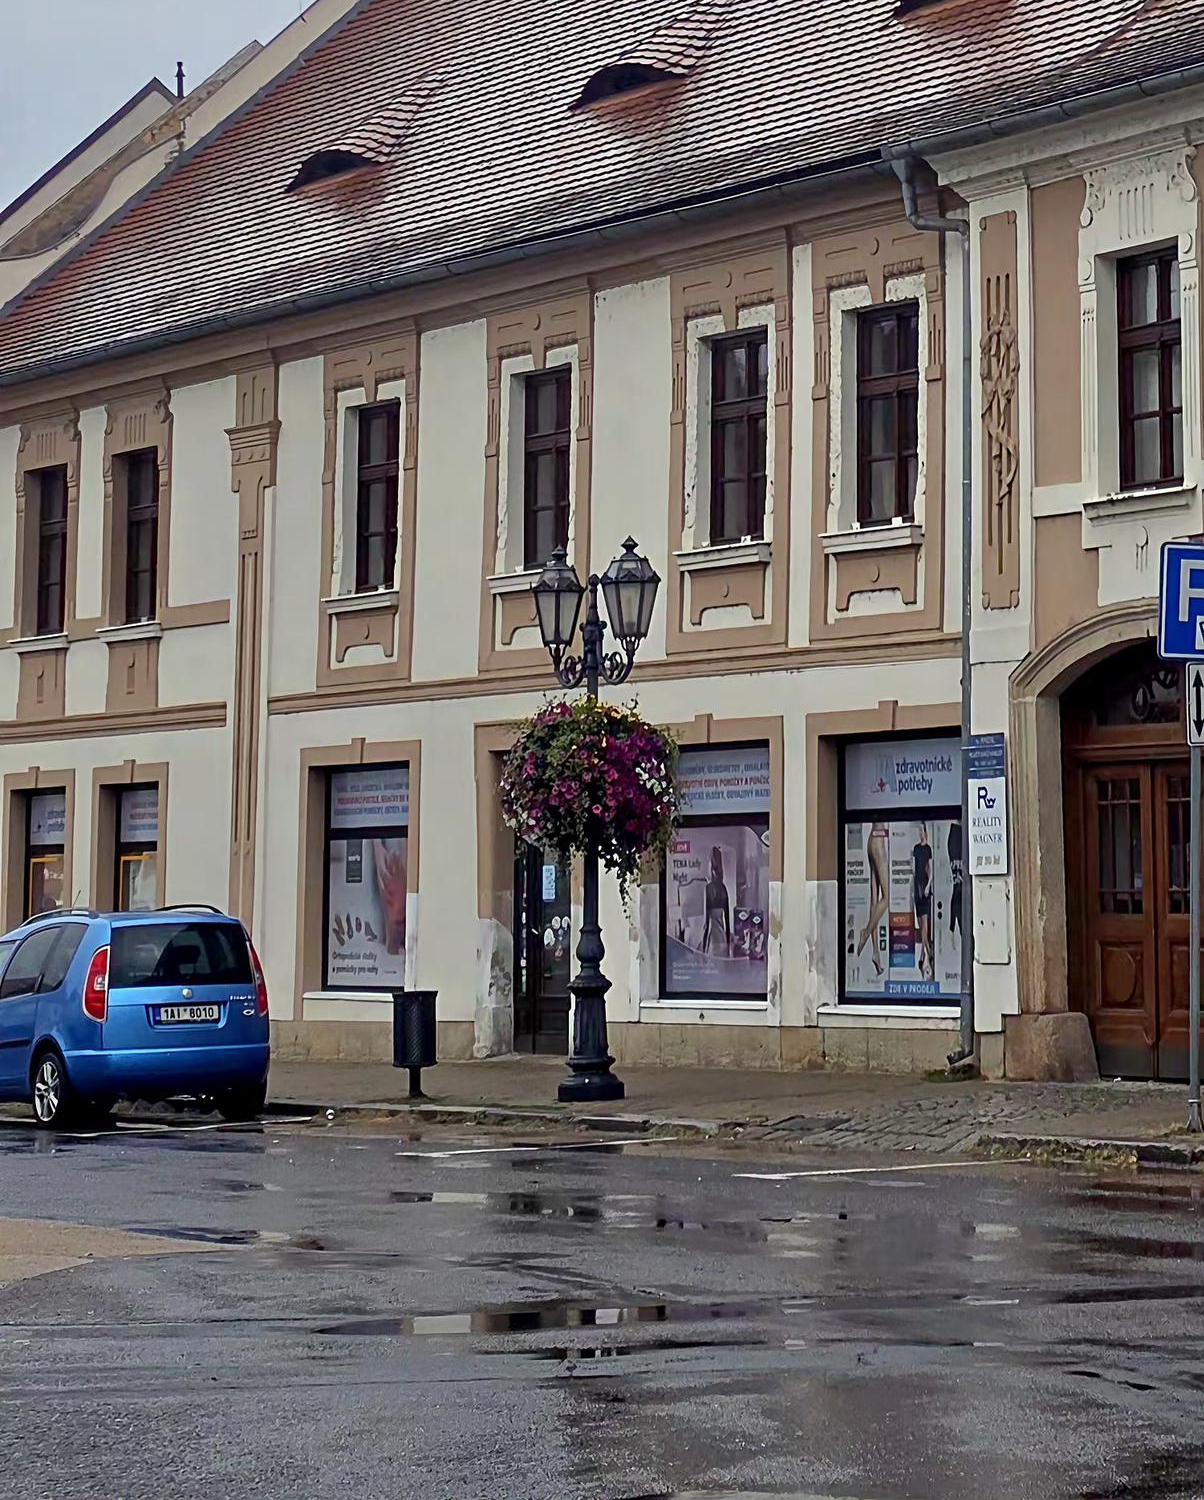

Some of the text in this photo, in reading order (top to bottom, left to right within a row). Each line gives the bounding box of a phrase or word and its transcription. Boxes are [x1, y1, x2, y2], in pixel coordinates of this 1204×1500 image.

[895, 756, 953, 775] zdravotnické
[897, 775, 933, 795] potřeby
[972, 816, 1002, 828] REALITY
[973, 833, 1003, 844] WAGNER
[189, 1007, 215, 1019] 8010
